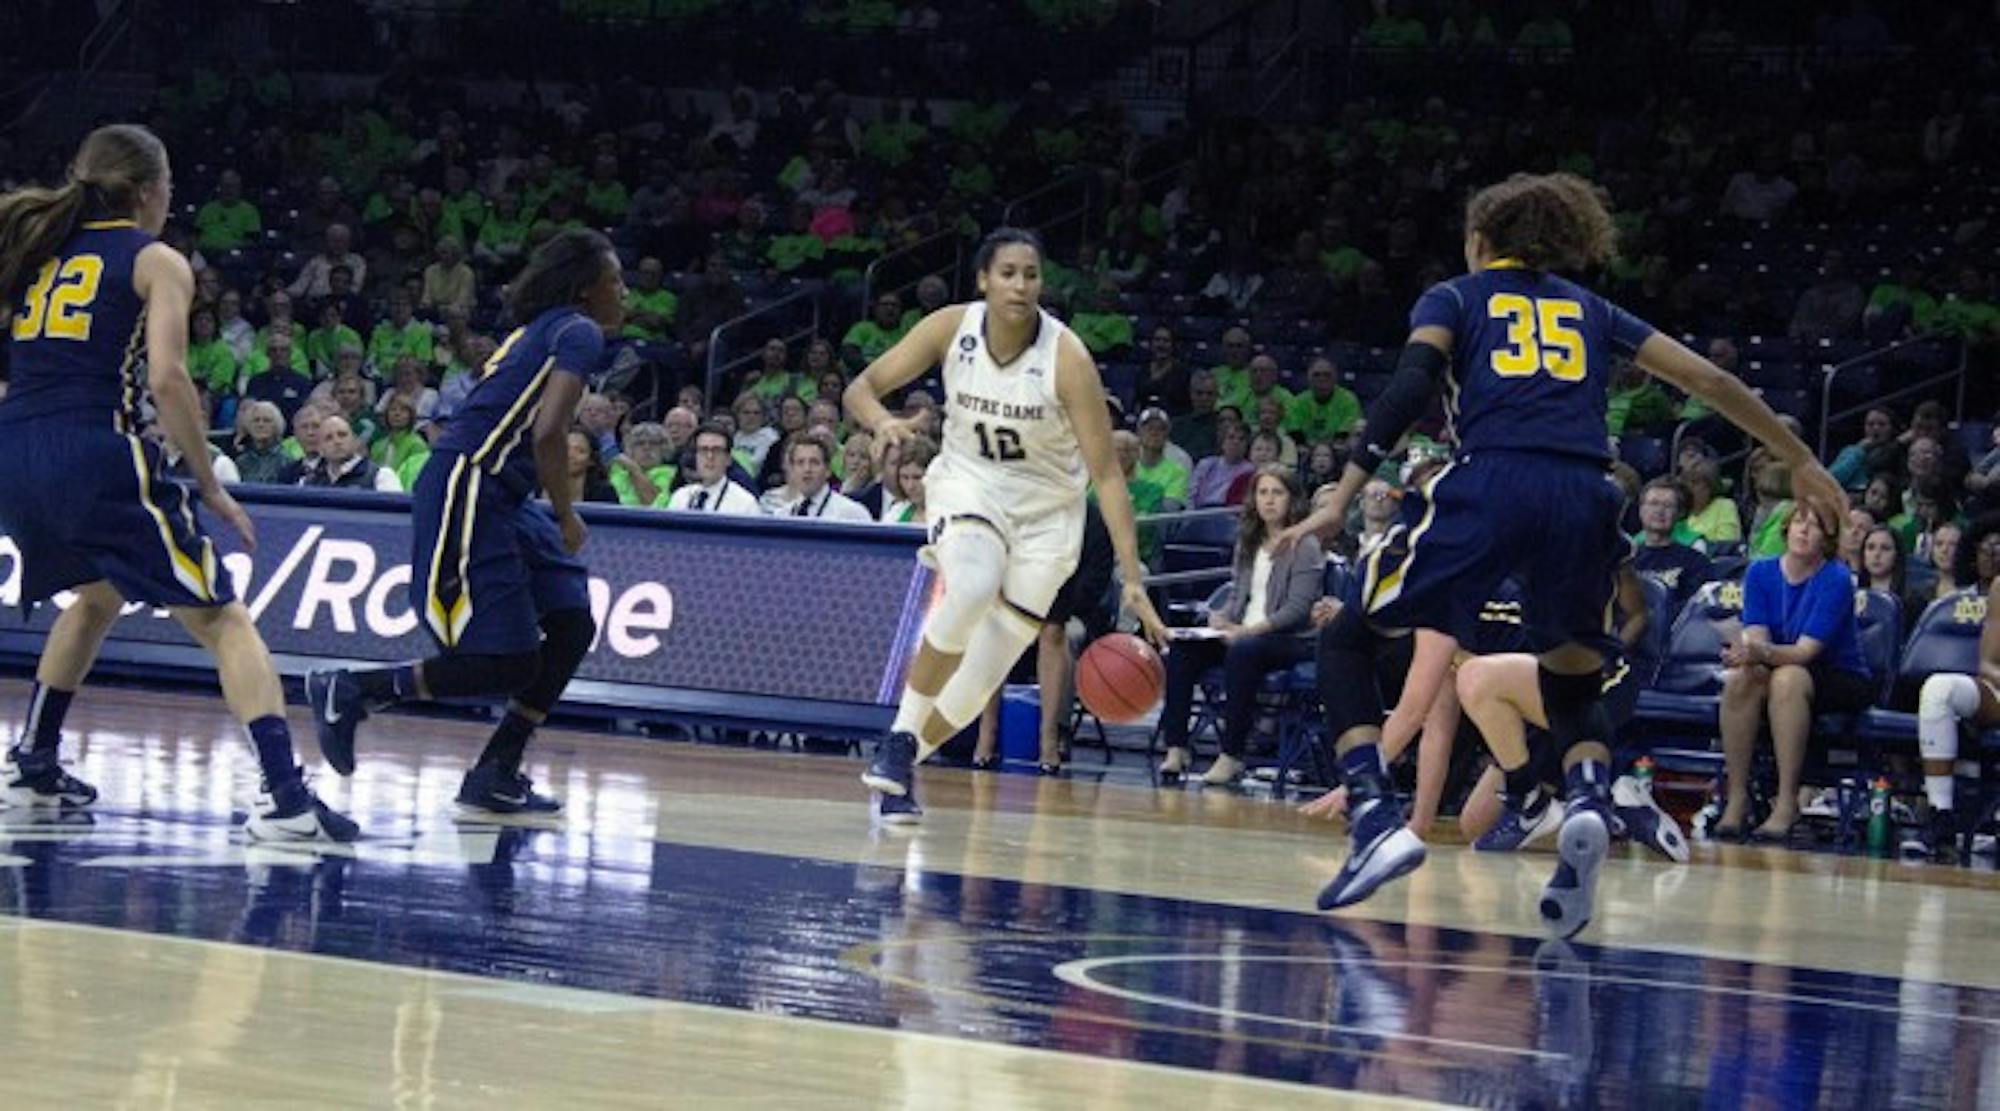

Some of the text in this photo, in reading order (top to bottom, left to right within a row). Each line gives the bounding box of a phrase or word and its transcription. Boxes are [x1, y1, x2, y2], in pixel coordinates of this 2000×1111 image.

[12, 253, 104, 341] 32
[1487, 292, 1587, 382] 35
[957, 391, 1044, 420] NOTRE DAME
[974, 422, 1026, 460] 12
